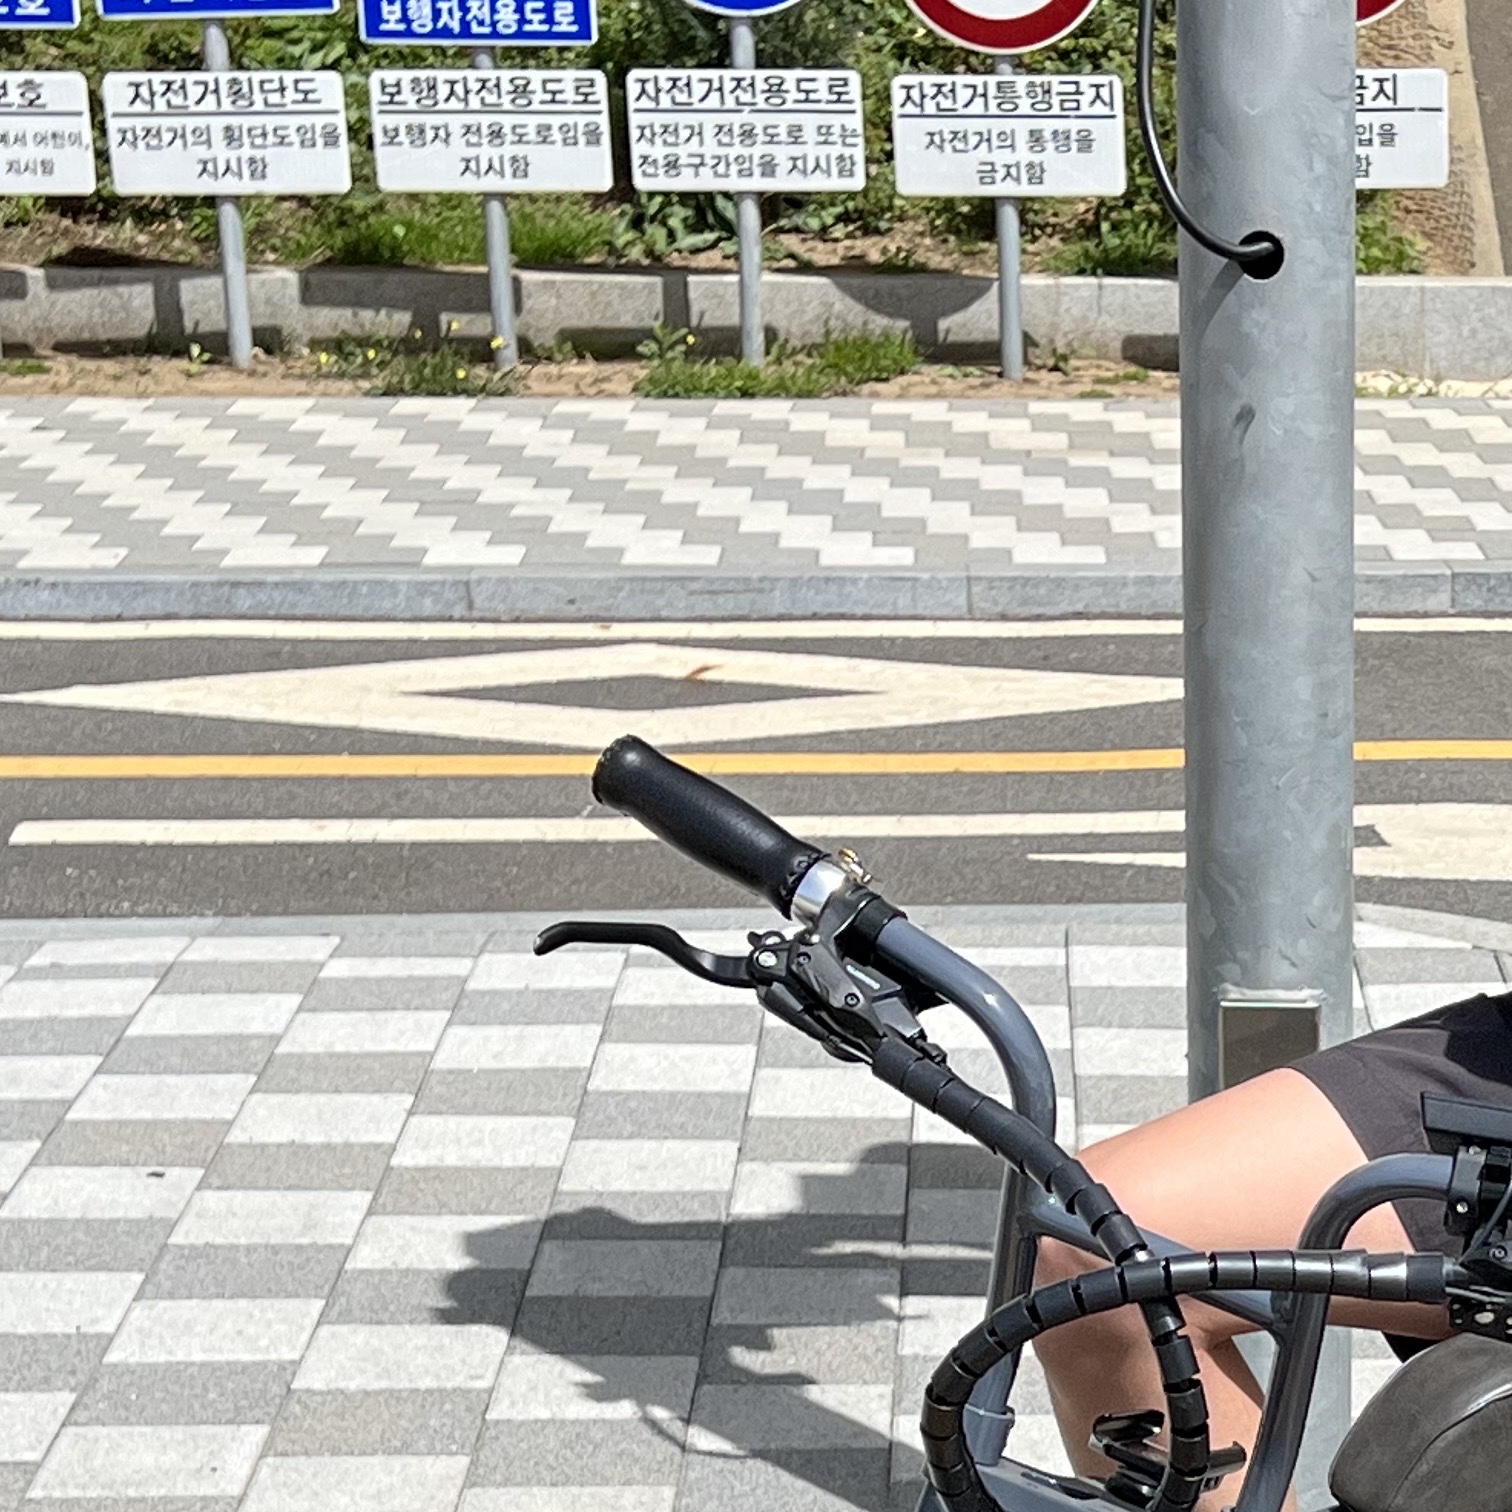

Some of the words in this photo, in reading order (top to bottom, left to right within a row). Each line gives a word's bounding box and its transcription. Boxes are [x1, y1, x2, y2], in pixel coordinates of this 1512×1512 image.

[379, 0, 580, 34] 보행자전용도로
[127, 75, 323, 111] 자전거횡단도
[377, 75, 602, 109] 보행자전용도로
[633, 74, 855, 107] 자전거전용도로
[899, 79, 1115, 113] 자전거통행금지
[117, 123, 213, 151] 자전거의
[222, 122, 342, 150] 횡단도임을
[381, 122, 452, 148] 보행자
[461, 121, 603, 148] 전용도로임을
[635, 122, 704, 148] 자전거
[713, 122, 808, 148] 전용도로
[816, 124, 861, 148] 또는
[924, 128, 1017, 154] 자전거의
[1026, 128, 1097, 154] 통행을
[197, 155, 269, 181] 지시함
[459, 154, 530, 180] 지시함
[638, 153, 780, 179] 전용구간임을
[787, 153, 857, 179] 지시함
[976, 160, 1047, 186] 금지함
